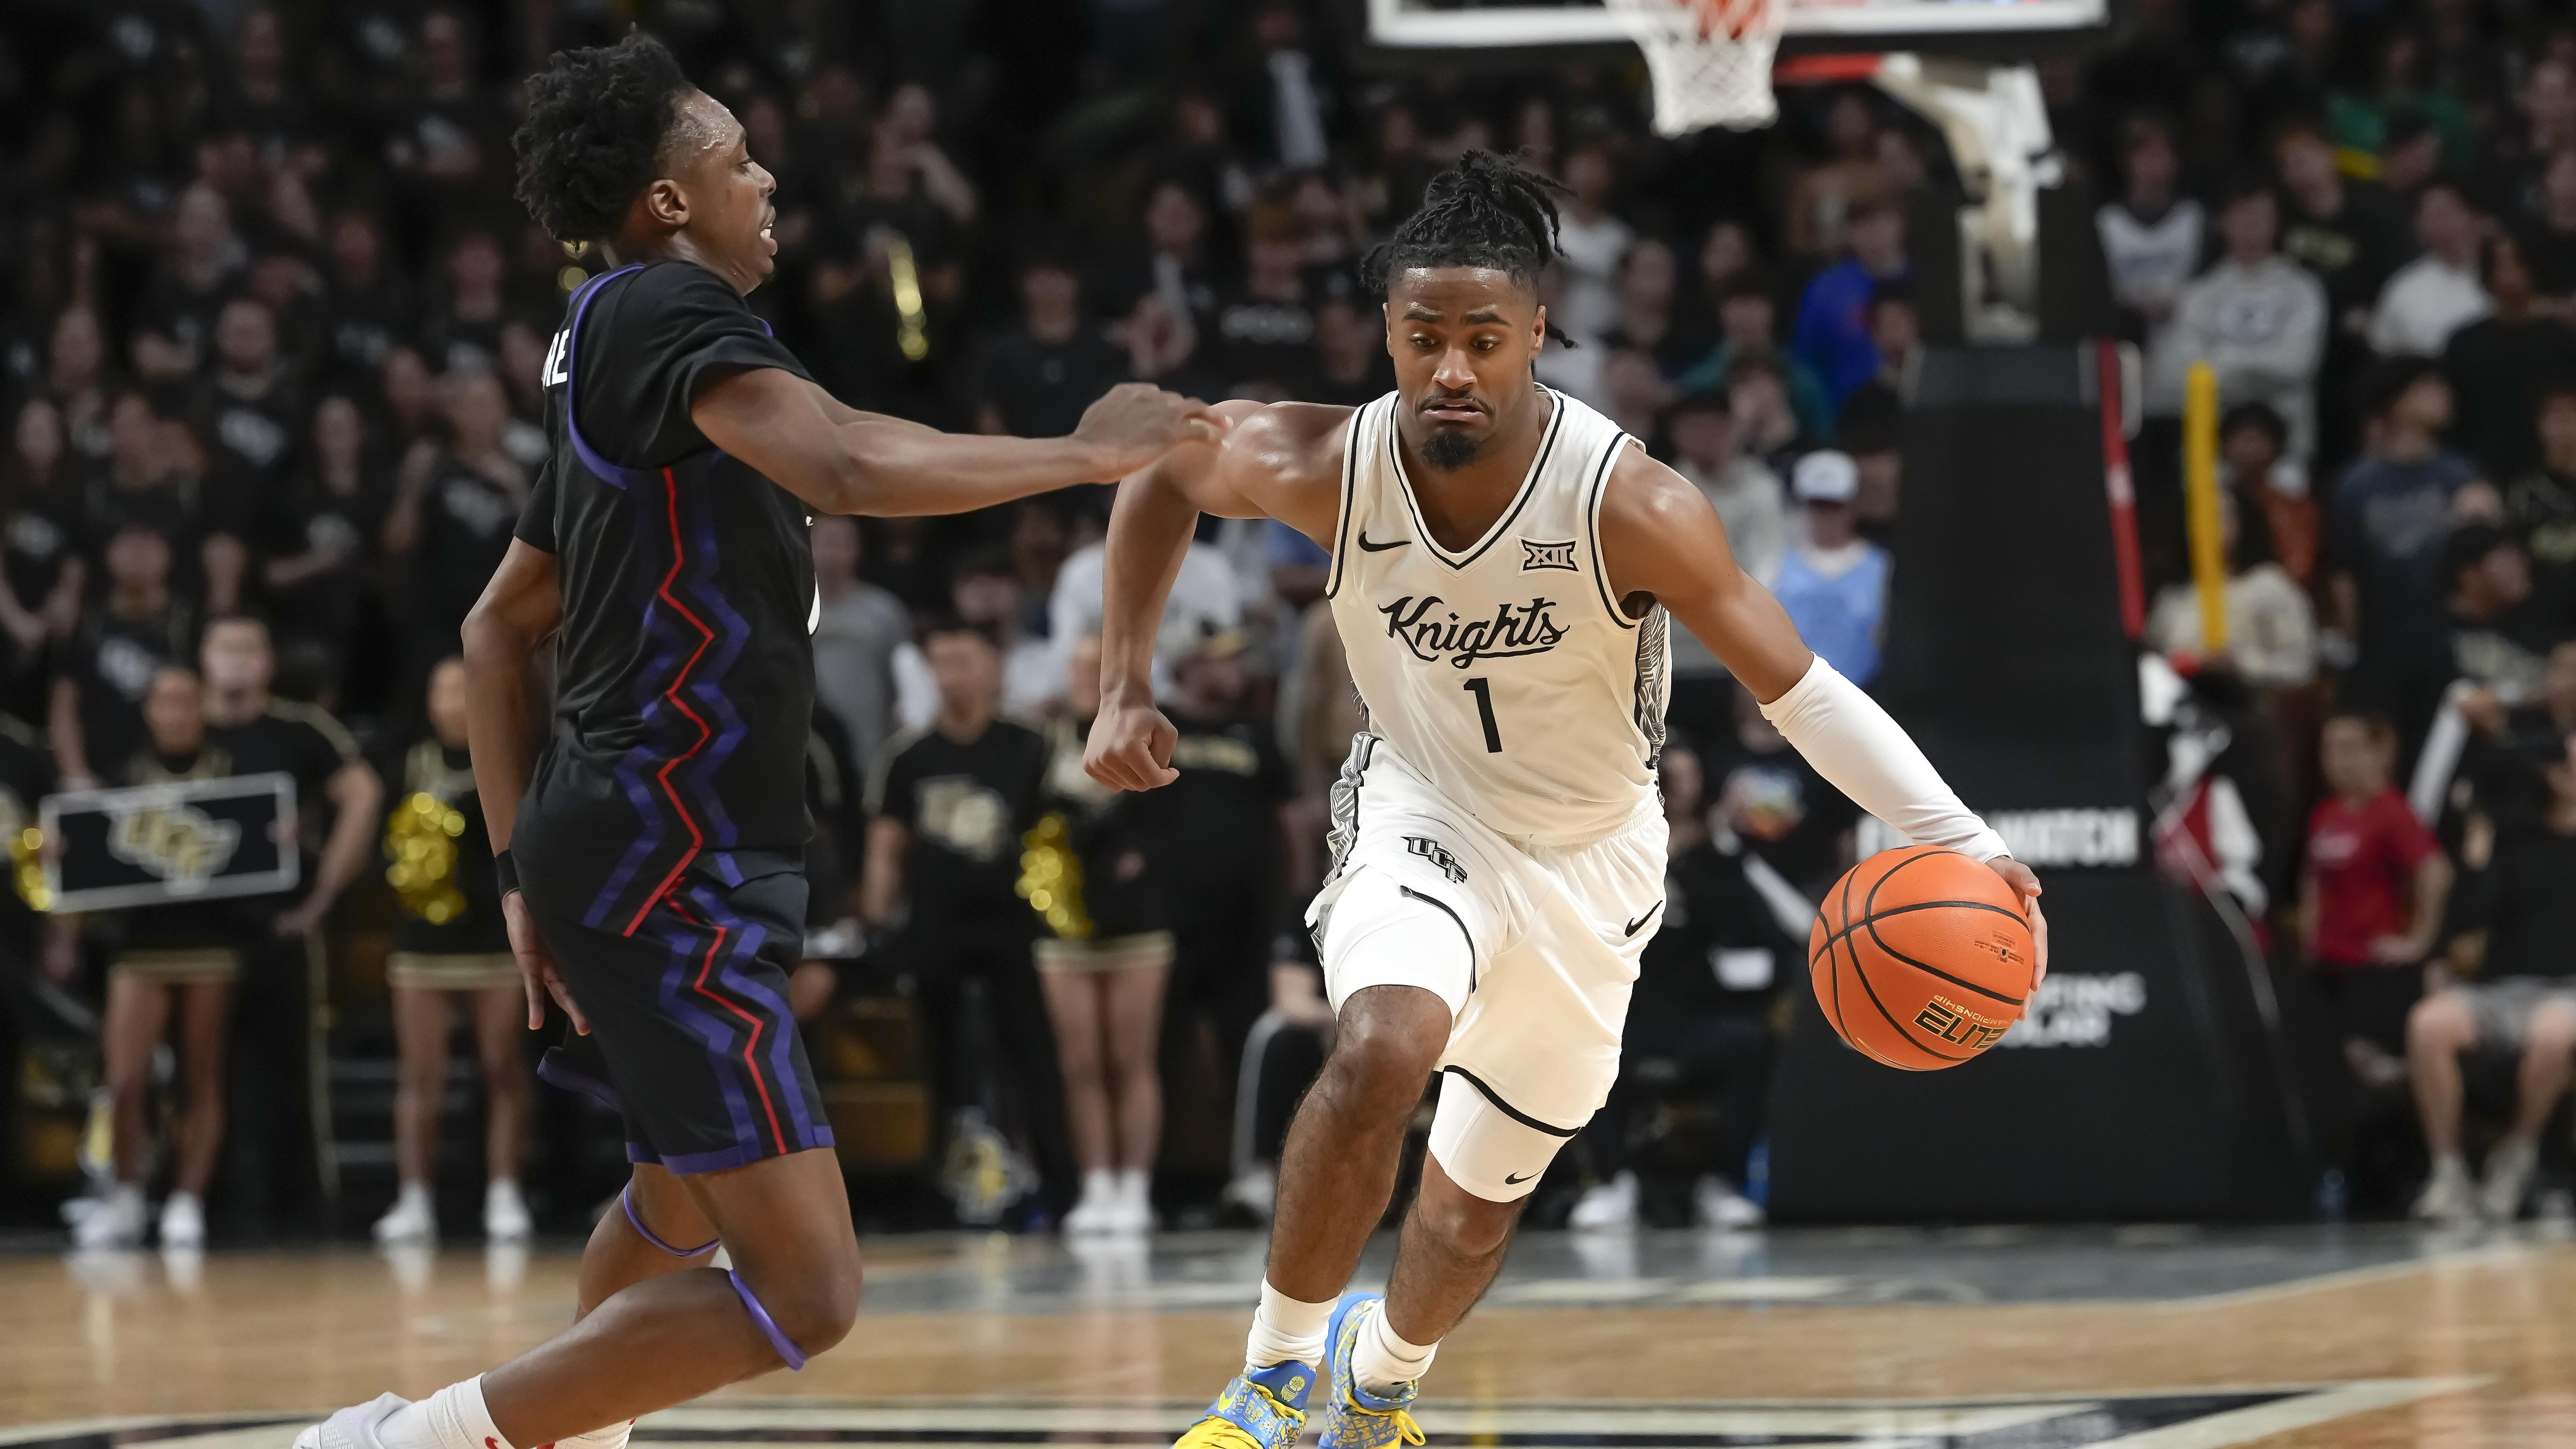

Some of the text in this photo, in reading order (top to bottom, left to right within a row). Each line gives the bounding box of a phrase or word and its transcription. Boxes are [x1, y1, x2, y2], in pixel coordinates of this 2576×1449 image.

[541, 329, 570, 387] RE
[1522, 542, 1577, 570] XII
[1378, 595, 1570, 669] Knights
[1463, 677, 1503, 753] 1
[1400, 836, 1467, 884] UCF
[1912, 1000, 2008, 1050] ELITE
[1933, 994, 2009, 1027] AMPIONSHIP
